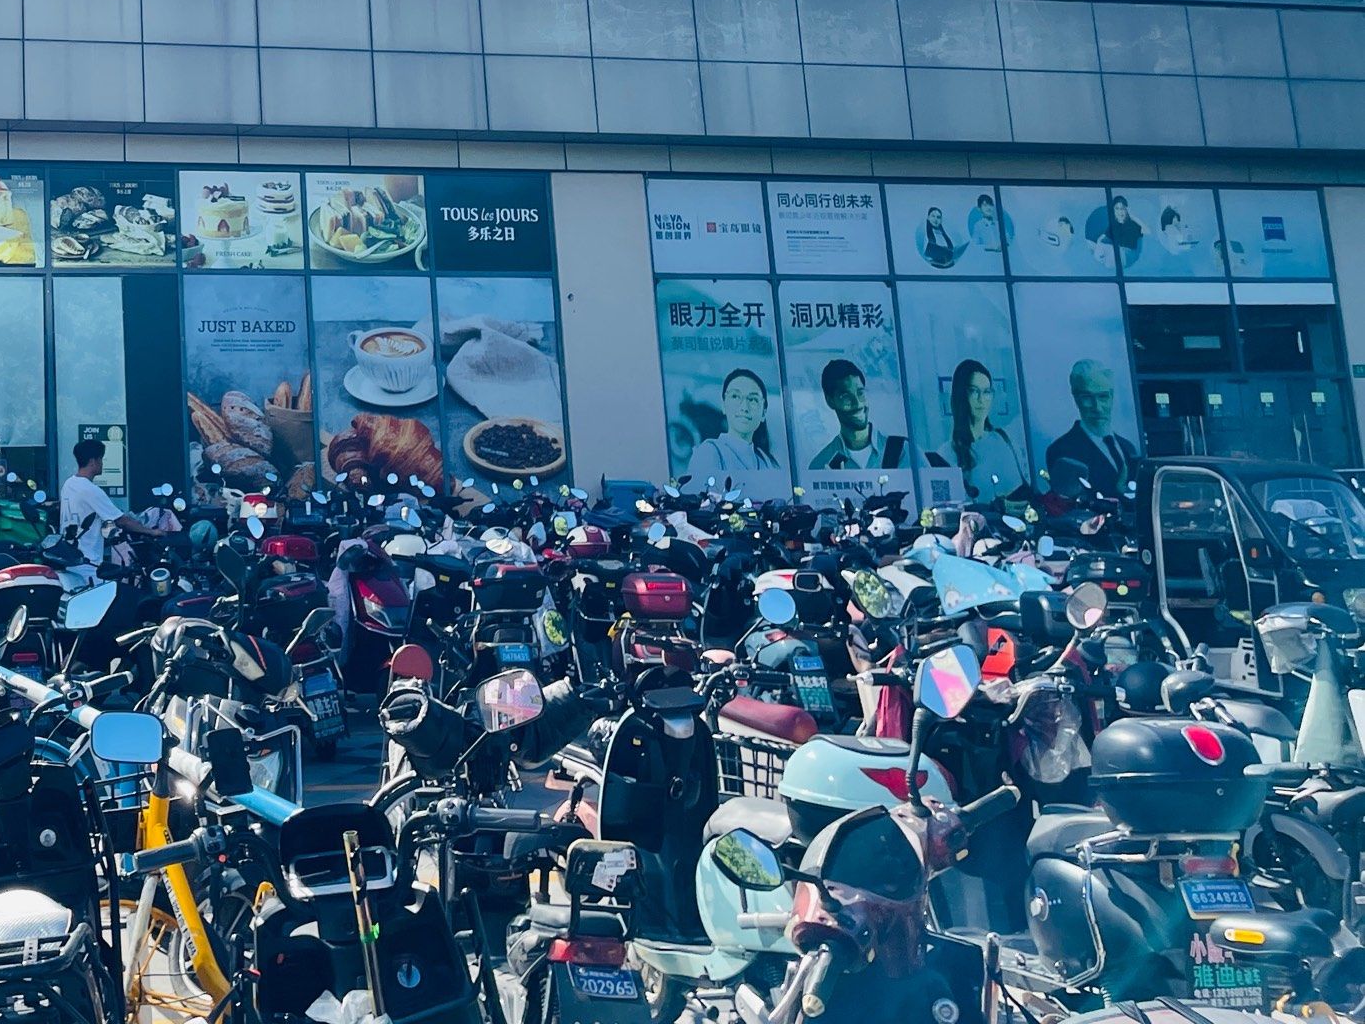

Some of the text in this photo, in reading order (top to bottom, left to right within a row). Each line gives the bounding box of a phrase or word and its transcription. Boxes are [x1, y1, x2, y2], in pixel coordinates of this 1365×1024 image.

[776, 192, 874, 209] 同心同行创未来
[440, 207, 539, 223] TOUS les JOURS
[467, 226, 515, 241] 多乐之日
[655, 221, 691, 231] VISION
[670, 302, 766, 328] 眼力全开
[789, 302, 885, 329] 洞见精彩
[198, 320, 296, 333] JUST BAKED
[579, 977, 635, 995] 202965
